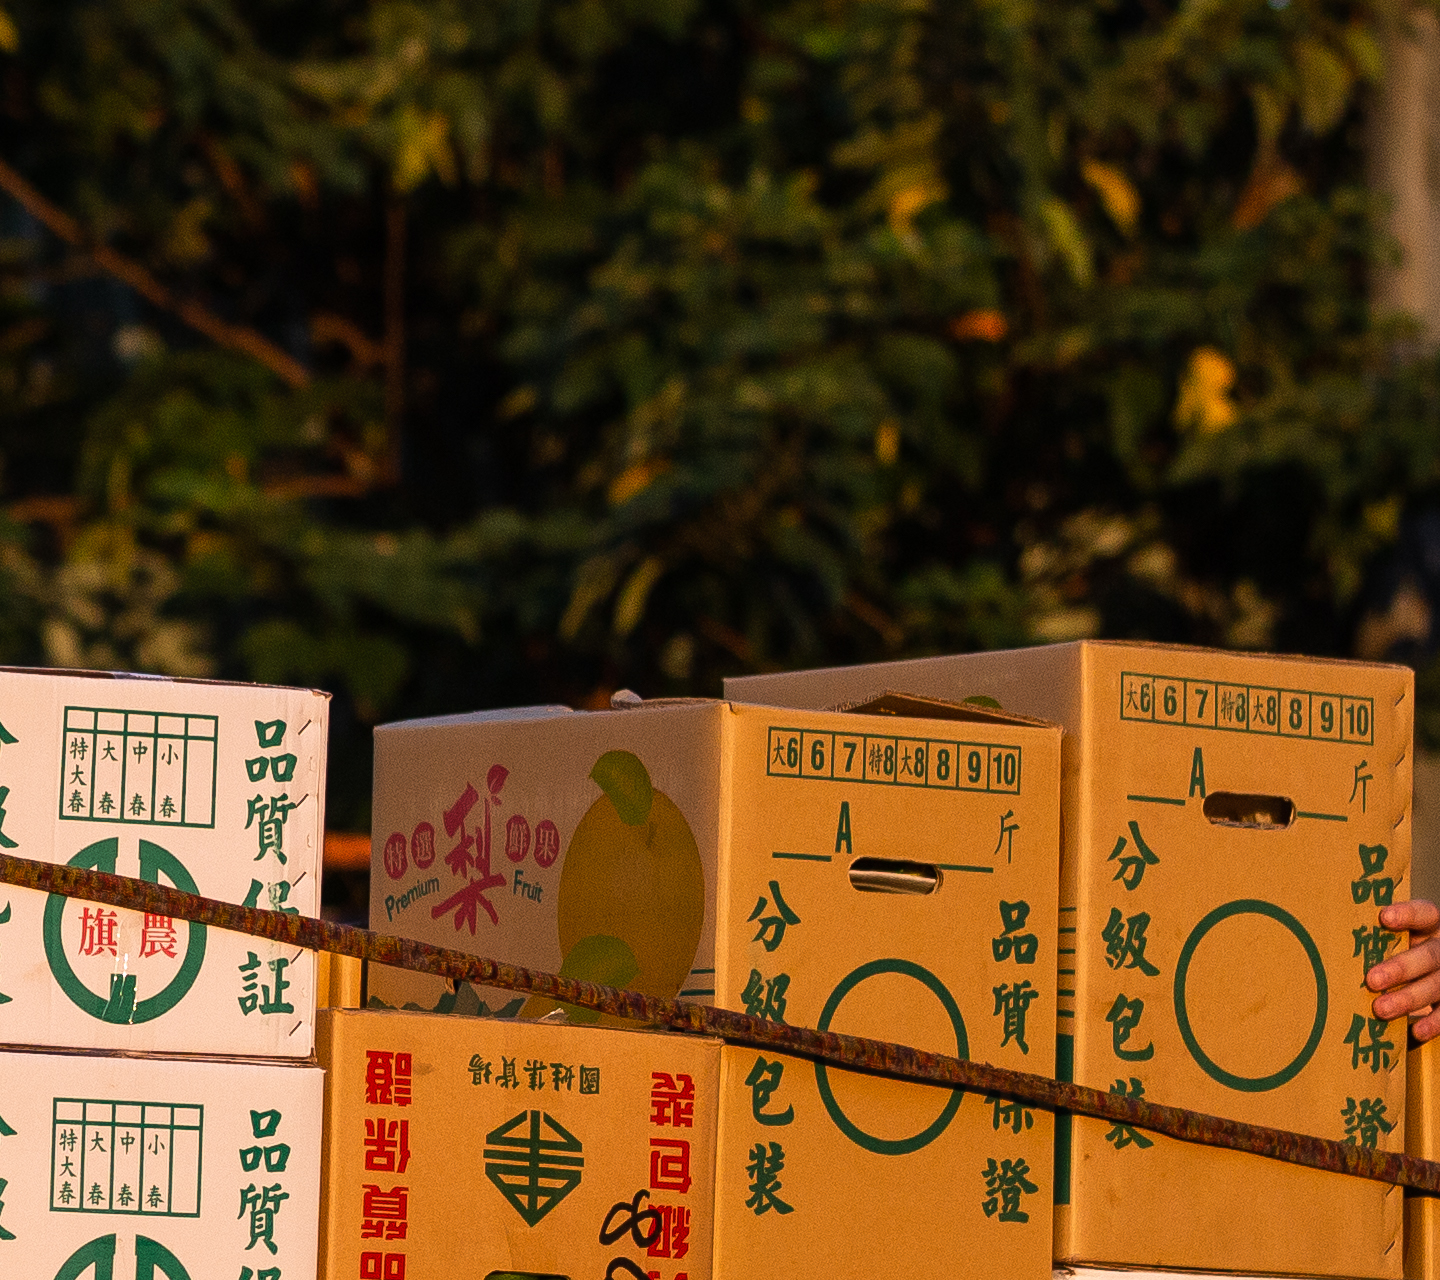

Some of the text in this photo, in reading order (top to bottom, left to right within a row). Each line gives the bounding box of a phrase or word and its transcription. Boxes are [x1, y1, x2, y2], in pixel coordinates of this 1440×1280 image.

[1162, 684, 1178, 716] 6
[1193, 687, 1210, 719] 7
[1287, 696, 1304, 730] 8
[1319, 700, 1335, 733] 9
[1344, 702, 1369, 737] 10
[809, 738, 825, 771] 6
[842, 740, 858, 773] 7
[935, 747, 951, 781] 8
[966, 749, 982, 783] 9
[991, 751, 1017, 786] 10
[1187, 746, 1373, 814] A 斤
[430, 764, 511, 938] 梨
[833, 801, 1020, 864] A 斤
[383, 869, 544, 922] Premium Fruit
[737, 880, 802, 1216] 分級包裝
